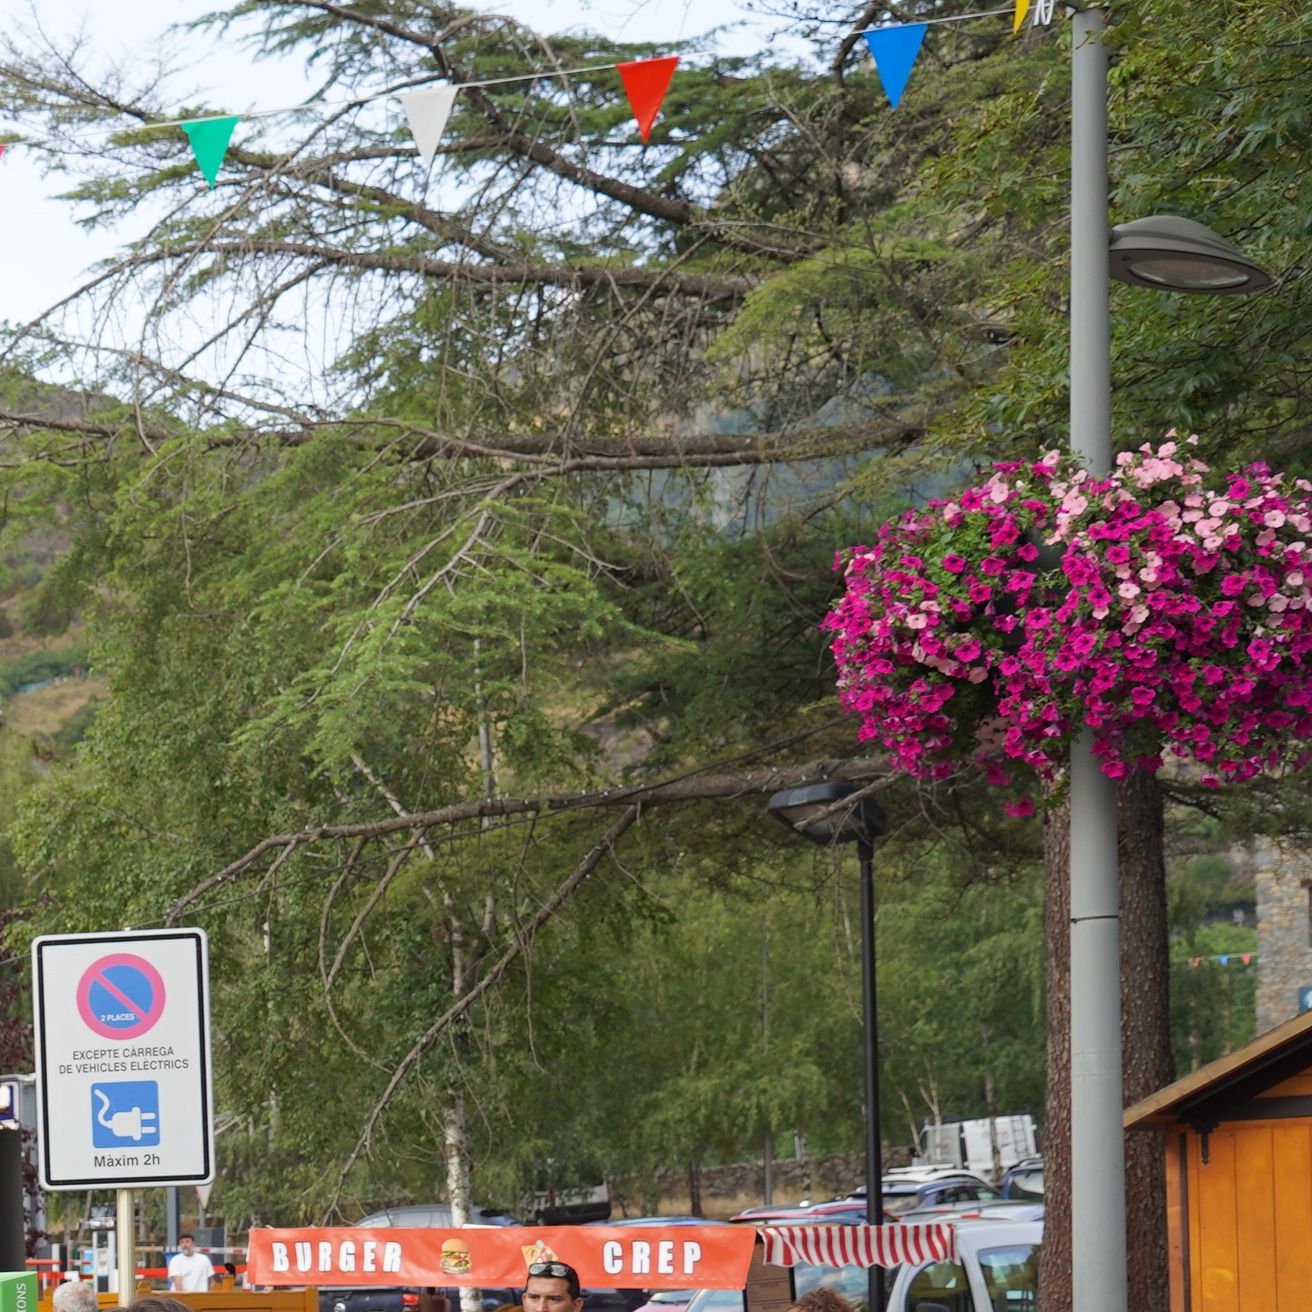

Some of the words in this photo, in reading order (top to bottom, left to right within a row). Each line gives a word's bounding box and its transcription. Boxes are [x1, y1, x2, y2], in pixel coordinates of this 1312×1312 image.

[100, 1014, 107, 1022] 2
[107, 1013, 135, 1021] PLACES
[72, 1049, 120, 1060] EXCEPTE
[122, 1045, 175, 1058] CÀRREGA
[59, 1064, 73, 1074] DE
[76, 1061, 127, 1073] VEHICLES
[130, 1058, 190, 1071] ELÈCTRICS
[94, 1155, 139, 1167] Màxim
[143, 1153, 161, 1165] 2h
[272, 1240, 403, 1273] BURGER
[602, 1240, 703, 1275] CREP
